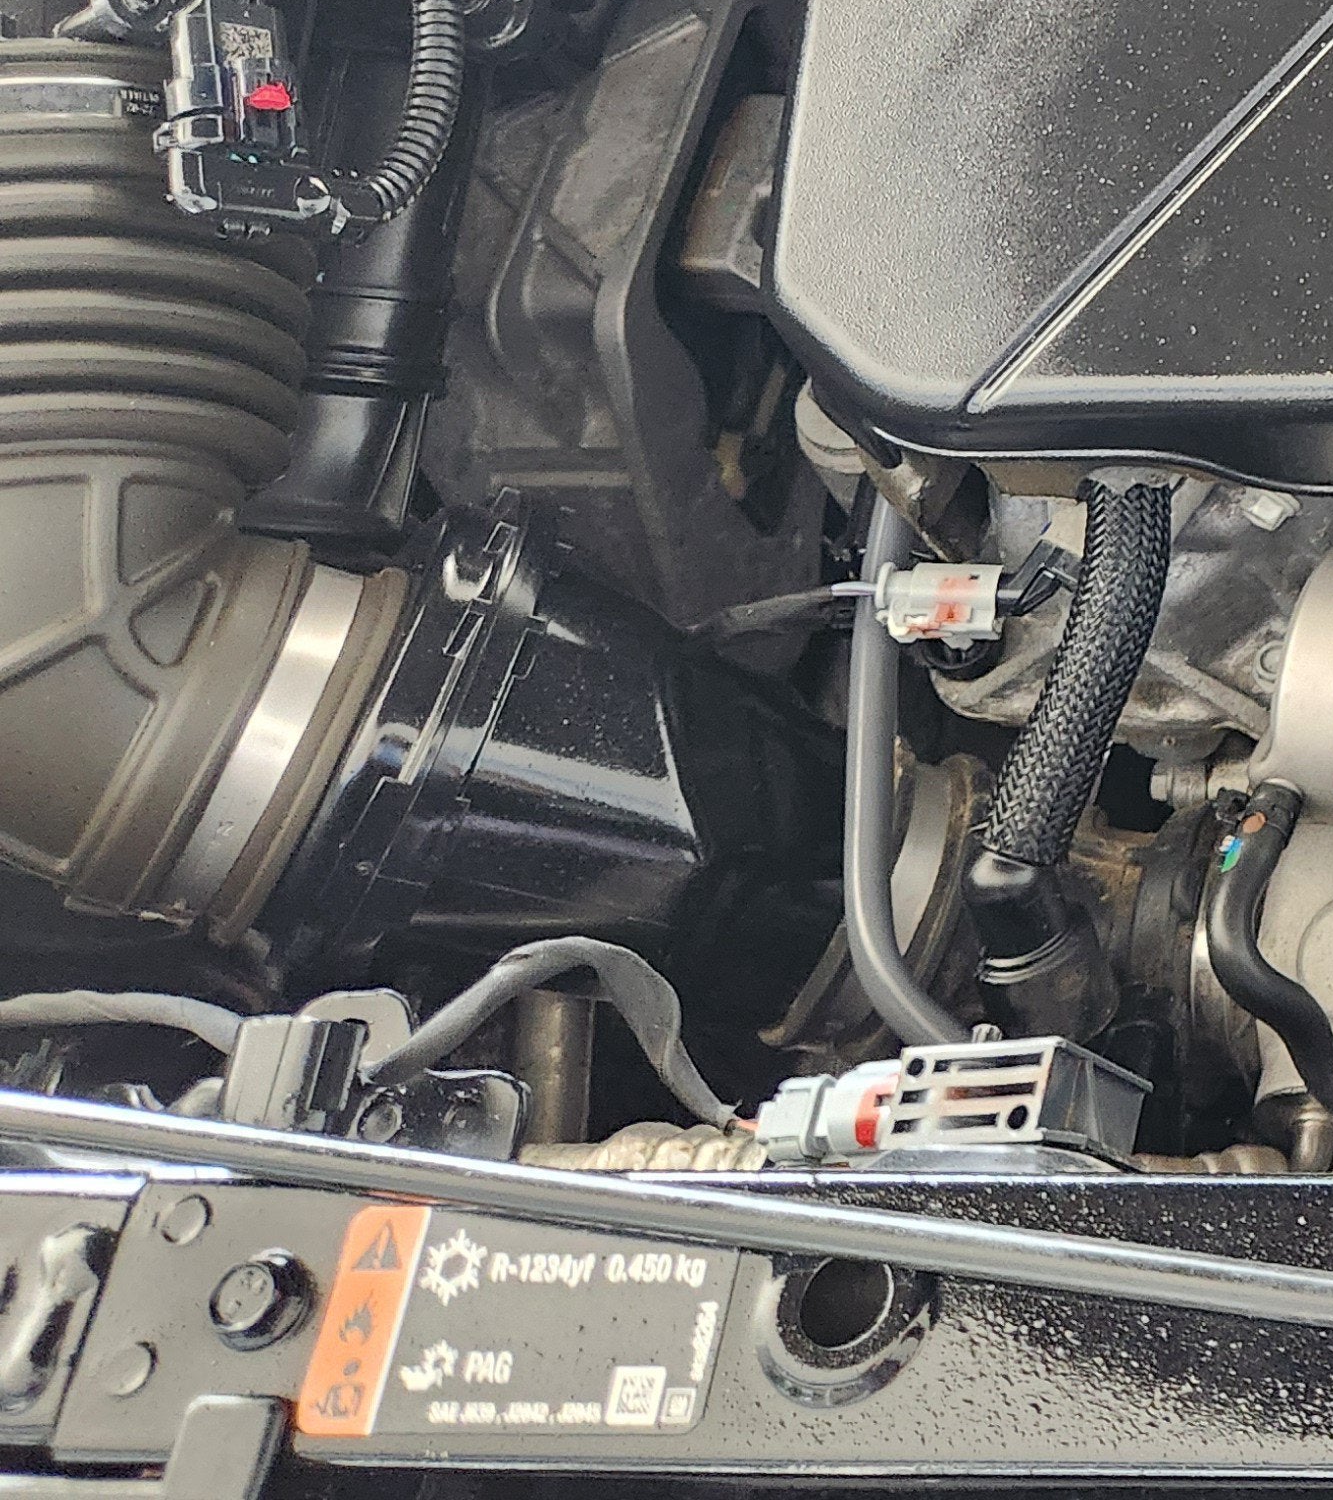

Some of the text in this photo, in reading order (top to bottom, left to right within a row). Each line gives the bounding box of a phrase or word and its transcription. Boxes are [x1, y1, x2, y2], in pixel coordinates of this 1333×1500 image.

[490, 1254, 707, 1288] R-1234yf 0.450 kg
[464, 1350, 513, 1384] PAG
